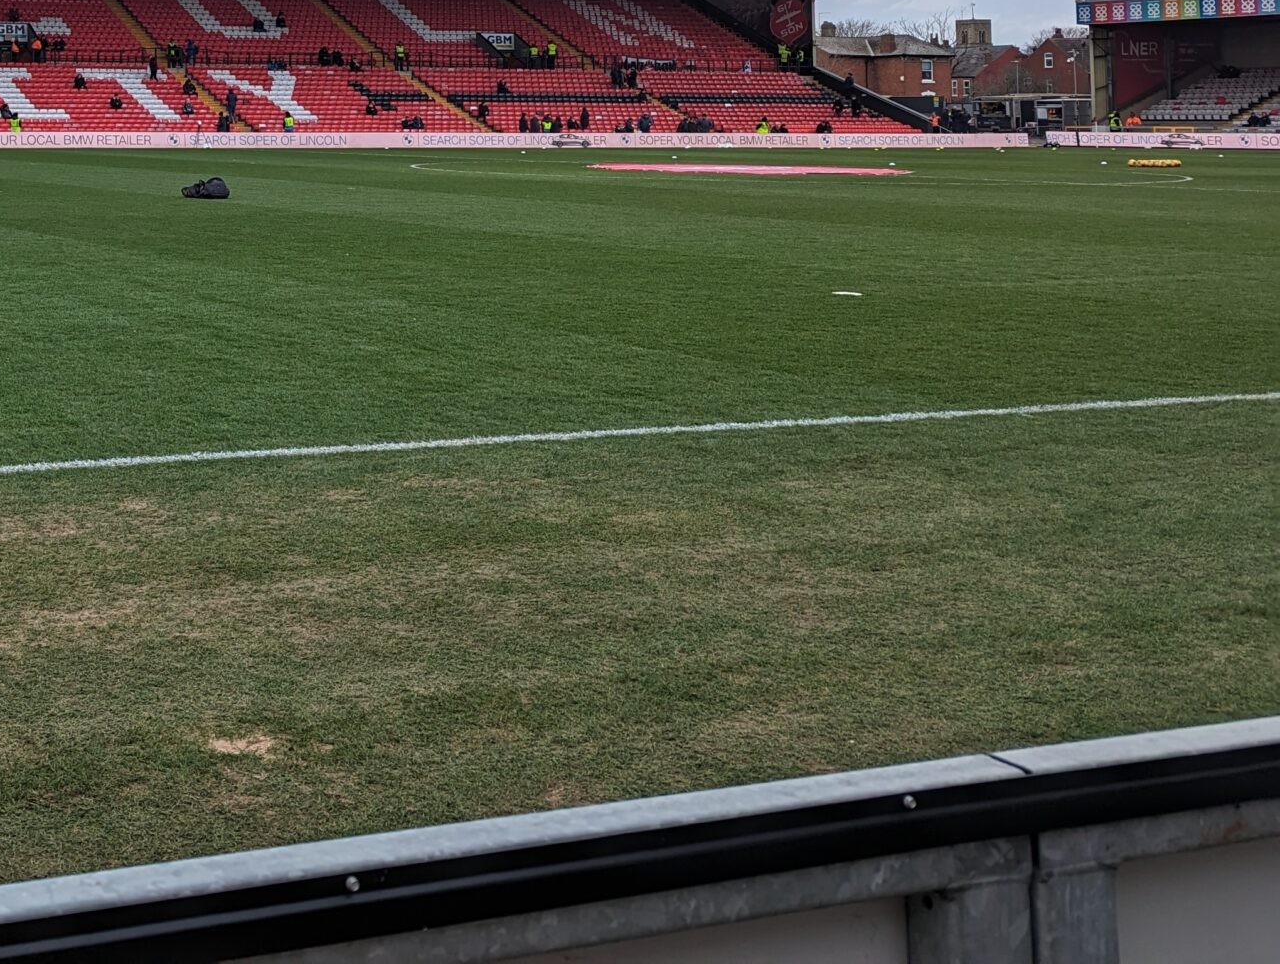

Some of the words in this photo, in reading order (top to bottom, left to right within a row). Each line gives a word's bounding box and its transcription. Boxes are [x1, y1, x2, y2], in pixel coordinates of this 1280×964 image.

[776, 0, 793, 13] 617
[780, 22, 804, 37] SON
[488, 35, 512, 45] GBM
[1121, 42, 1158, 57] LNER
[21, 134, 60, 146] LOCAL
[64, 134, 94, 146] BMW
[97, 134, 152, 146] RETAILER
[189, 135, 236, 146] SEARCH
[239, 135, 277, 146] SOPER
[281, 135, 296, 146] OF
[299, 135, 347, 146] LINCOLN
[423, 136, 465, 146] SEARCH
[469, 136, 506, 146] SOPER
[508, 136, 521, 146] OF
[639, 136, 675, 147] SOPER,
[677, 136, 704, 146] YOUR
[706, 136, 736, 146] LOCAL
[739, 136, 763, 146] BMW
[765, 136, 809, 146] RETAILER
[838, 136, 877, 146] SEARCH
[879, 136, 909, 146] SOPER
[911, 136, 925, 146] OF
[926, 136, 964, 146] LINCOLN
[1114, 135, 1128, 145] OF
